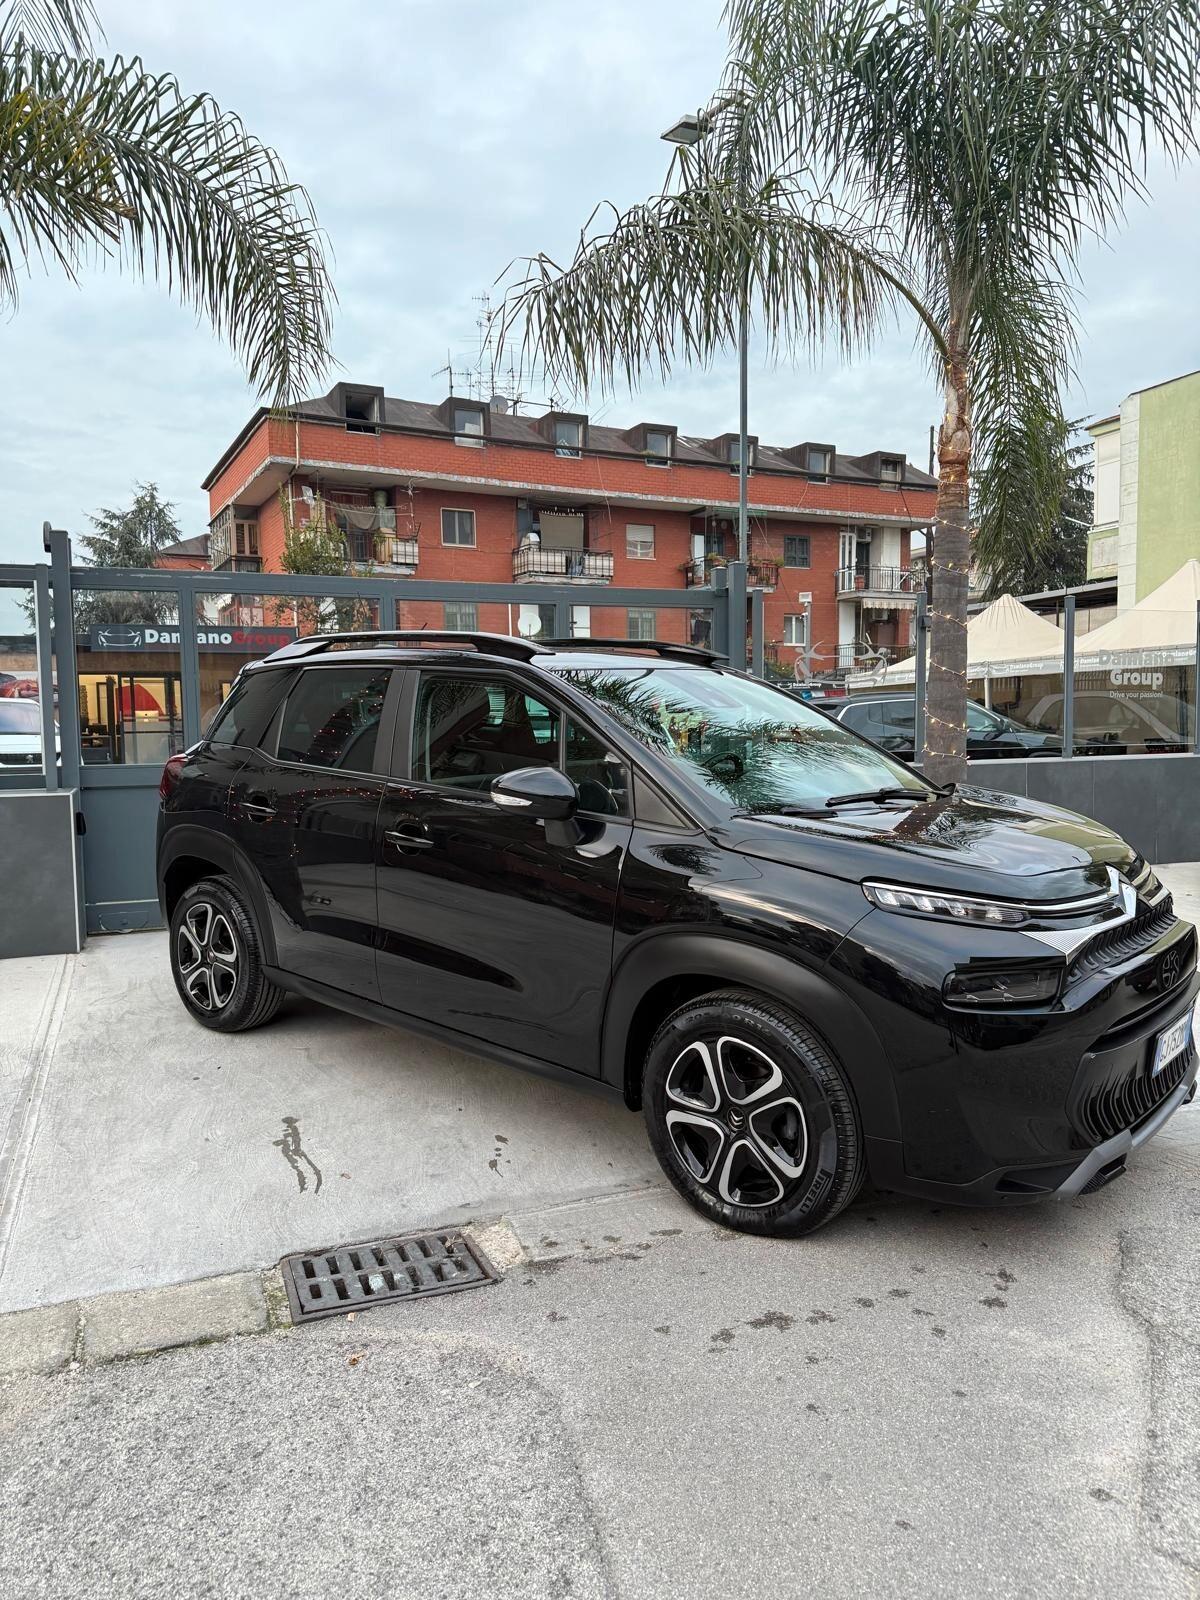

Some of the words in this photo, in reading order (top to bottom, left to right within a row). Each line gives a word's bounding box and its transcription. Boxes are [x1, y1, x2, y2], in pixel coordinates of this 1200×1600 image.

[145, 629, 290, 647] DamanoGroup
[1099, 649, 1175, 666] Damiano
[1110, 668, 1164, 690] Group
[1140, 691, 1163, 699] passion!
